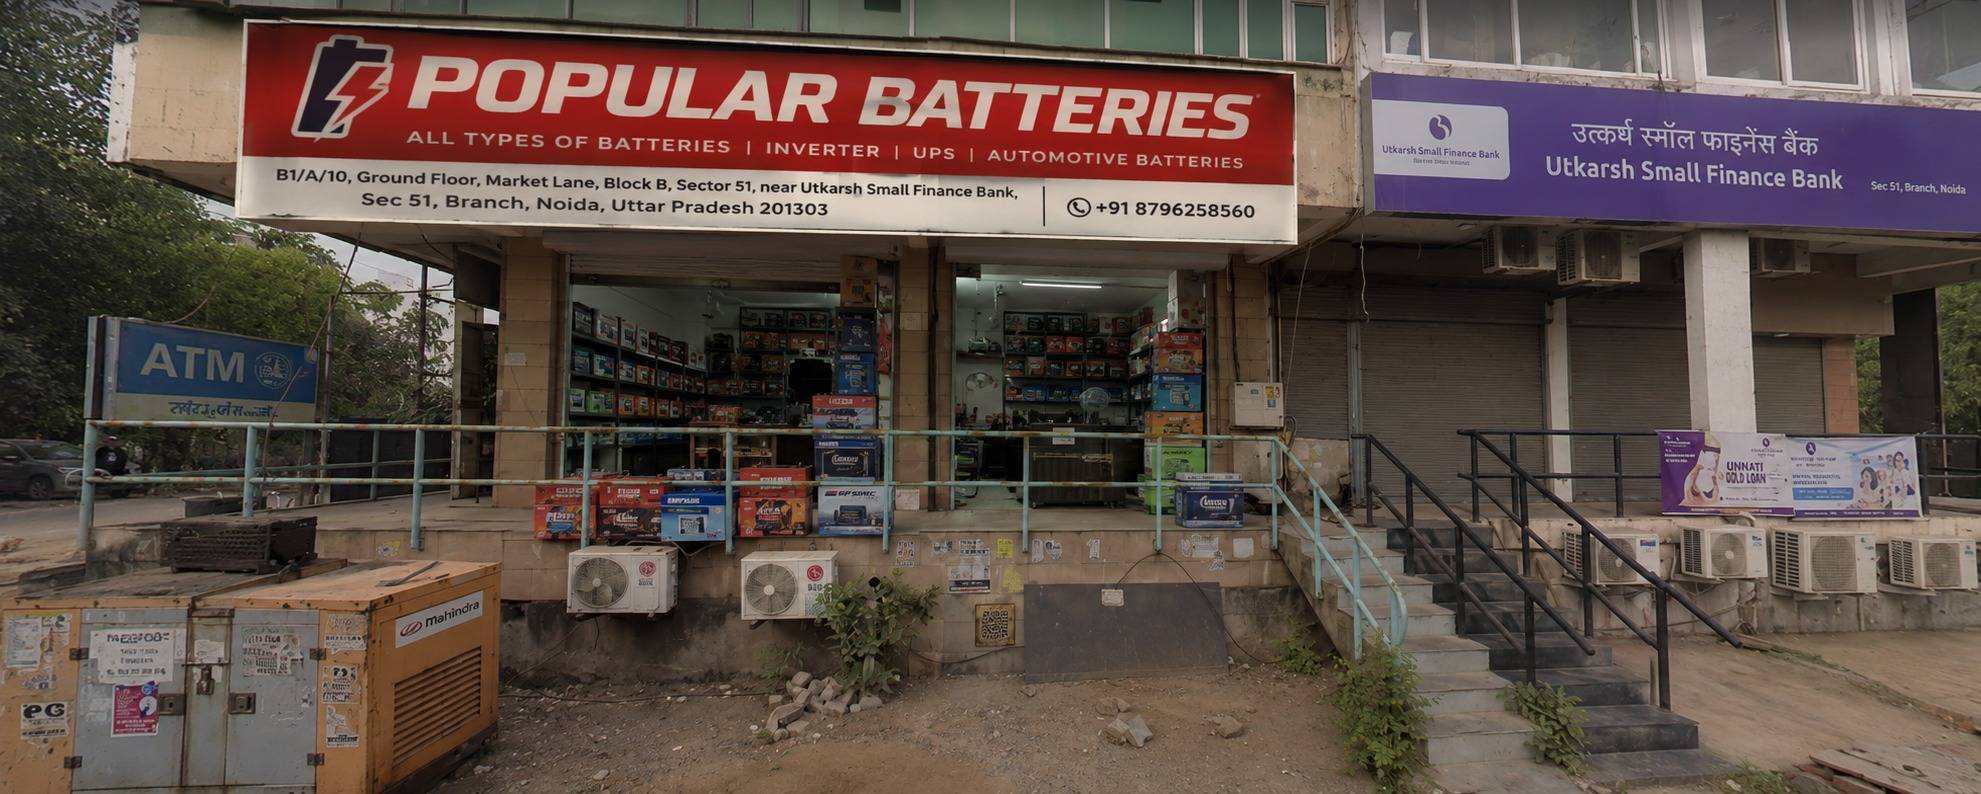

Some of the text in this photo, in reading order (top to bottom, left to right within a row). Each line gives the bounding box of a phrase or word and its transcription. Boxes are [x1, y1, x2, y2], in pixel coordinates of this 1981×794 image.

[407, 54, 1253, 140] POPULAR BATTERIES
[406, 131, 1244, 169] ALL TYPES OF BATTERIES INVERTER UPS AUTOMOTIVE BATTERIES
[1382, 145, 1500, 159] Utkarsh Small Finance Bank
[1640, 121, 1696, 150] स्मॉल
[1701, 126, 1777, 156] फाइनेंस
[1781, 128, 1819, 156] बैंक
[276, 168, 1018, 200] B1/A/10, Ground Floor, Market Lane, Block B, Sector 51, near Utkarsh Small Finance Bank,
[1546, 156, 1843, 190] Utkarsh Small Finance Bank
[1871, 181, 1966, 194] Sec 51, Branch, Noida
[361, 192, 828, 216] Sec 51, Branch, Noida, Uttar Pradesh 201303
[1096, 201, 1255, 218] +91 8796258560
[140, 342, 245, 383] ATM
[1726, 461, 1763, 472] UNNATI
[425, 601, 480, 628] mahindra
